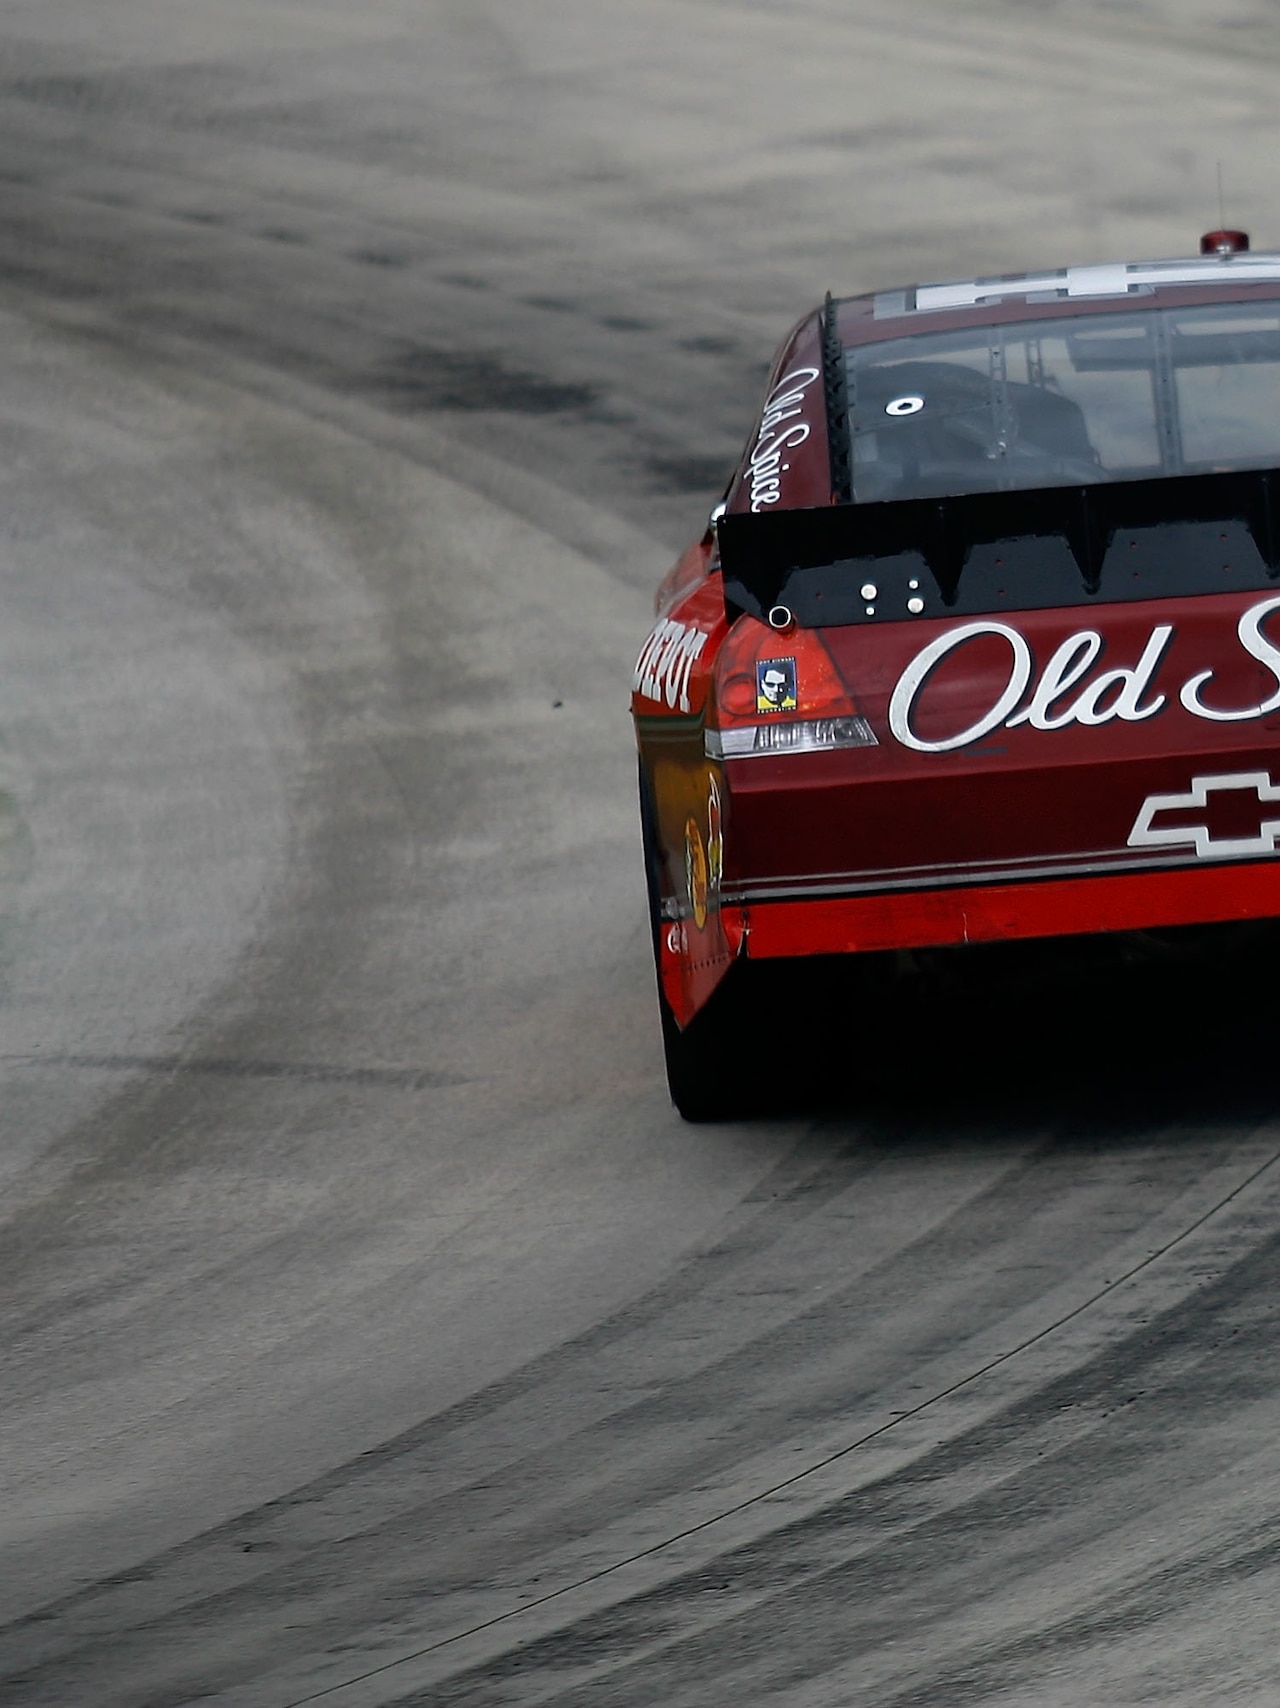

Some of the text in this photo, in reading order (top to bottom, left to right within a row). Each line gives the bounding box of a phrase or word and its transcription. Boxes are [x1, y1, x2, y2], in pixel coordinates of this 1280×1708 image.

[743, 367, 820, 513] Old Spice
[631, 617, 708, 713] DEPOT
[888, 620, 1174, 753] Old
